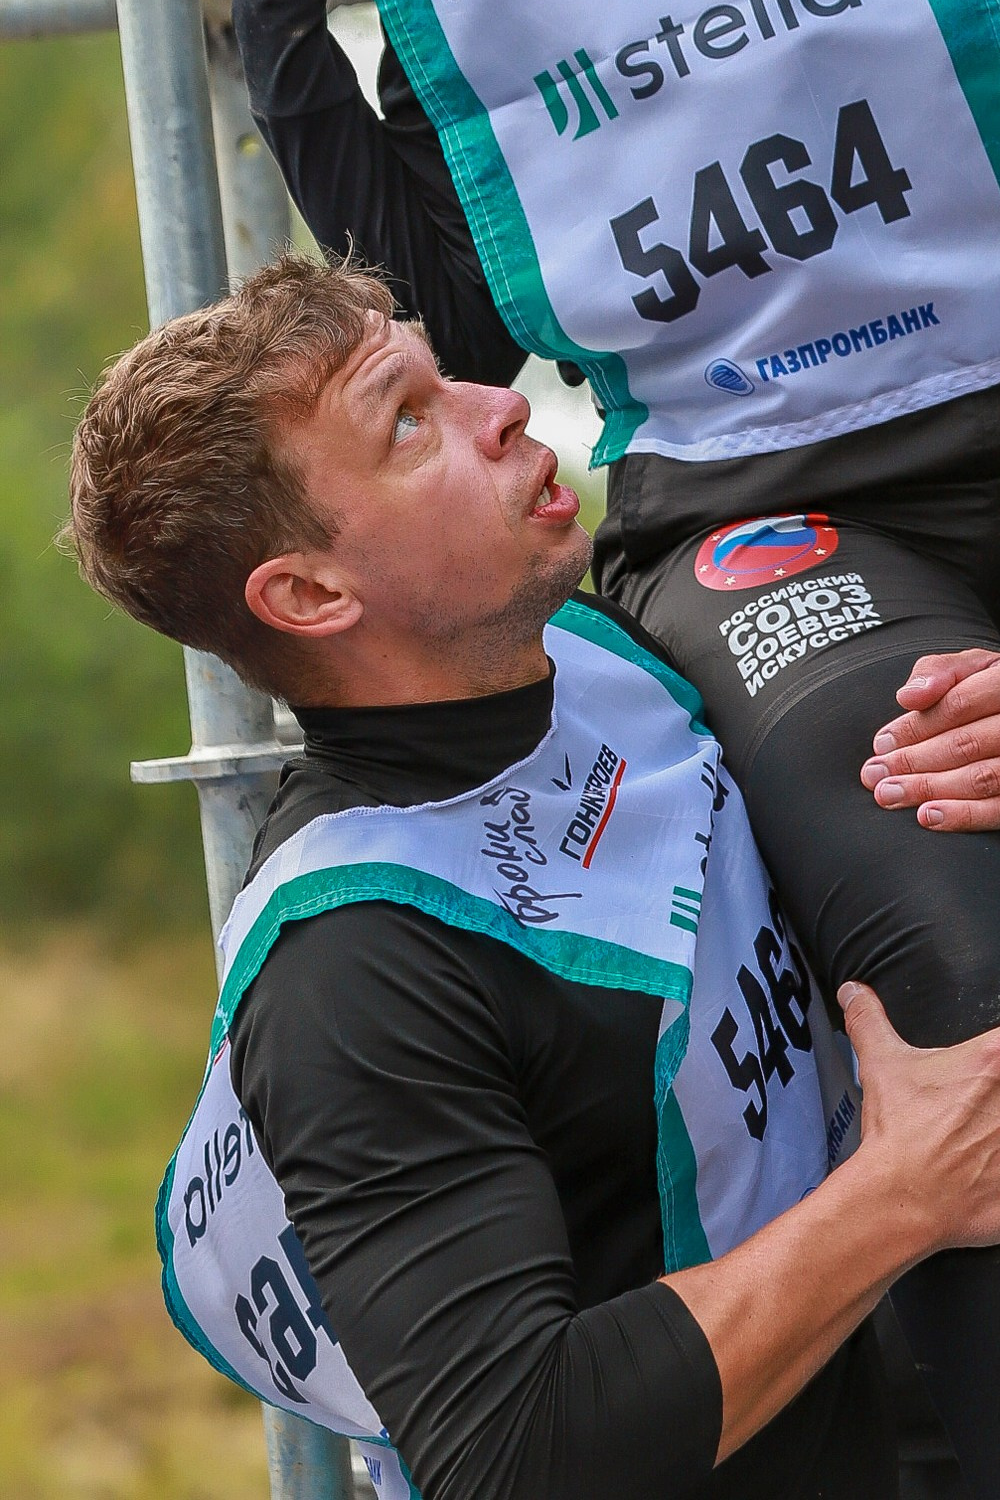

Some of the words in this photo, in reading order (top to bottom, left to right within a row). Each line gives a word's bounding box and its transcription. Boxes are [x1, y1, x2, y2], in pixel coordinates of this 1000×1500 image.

[609, 98, 913, 323] 5464
[755, 302, 940, 381] ГАЗПРОМБАНК
[718, 572, 864, 636] РОССИЙСКИЙ
[728, 585, 872, 656] СОЮЗ
[736, 604, 881, 680] БОЕВЫХ
